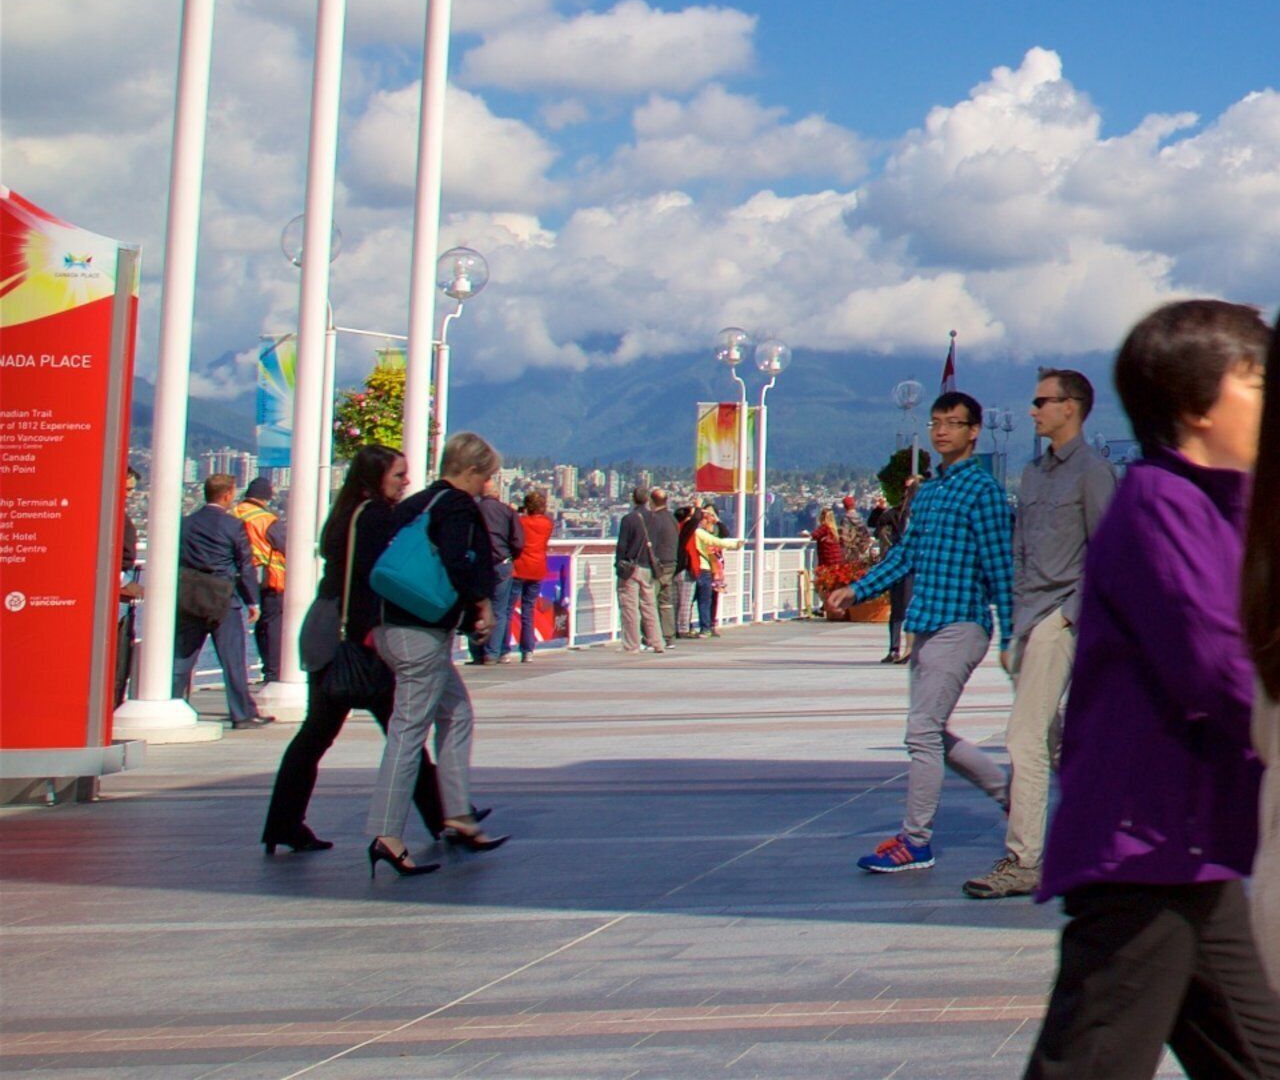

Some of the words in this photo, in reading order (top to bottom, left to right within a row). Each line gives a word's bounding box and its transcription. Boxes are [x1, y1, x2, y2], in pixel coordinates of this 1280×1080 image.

[40, 354, 92, 368] PLACE
[32, 408, 53, 418] Trail
[6, 421, 16, 430] of
[18, 421, 38, 430] 1812
[40, 421, 92, 432] Experience
[17, 434, 64, 442] Vancouver
[2, 452, 36, 461] Canada
[12, 464, 36, 473] Point
[17, 498, 58, 507] Terminal
[10, 510, 62, 519] Convention
[13, 532, 37, 541] Hotel
[15, 544, 48, 554] Centre
[30, 599, 77, 607] vancouver
